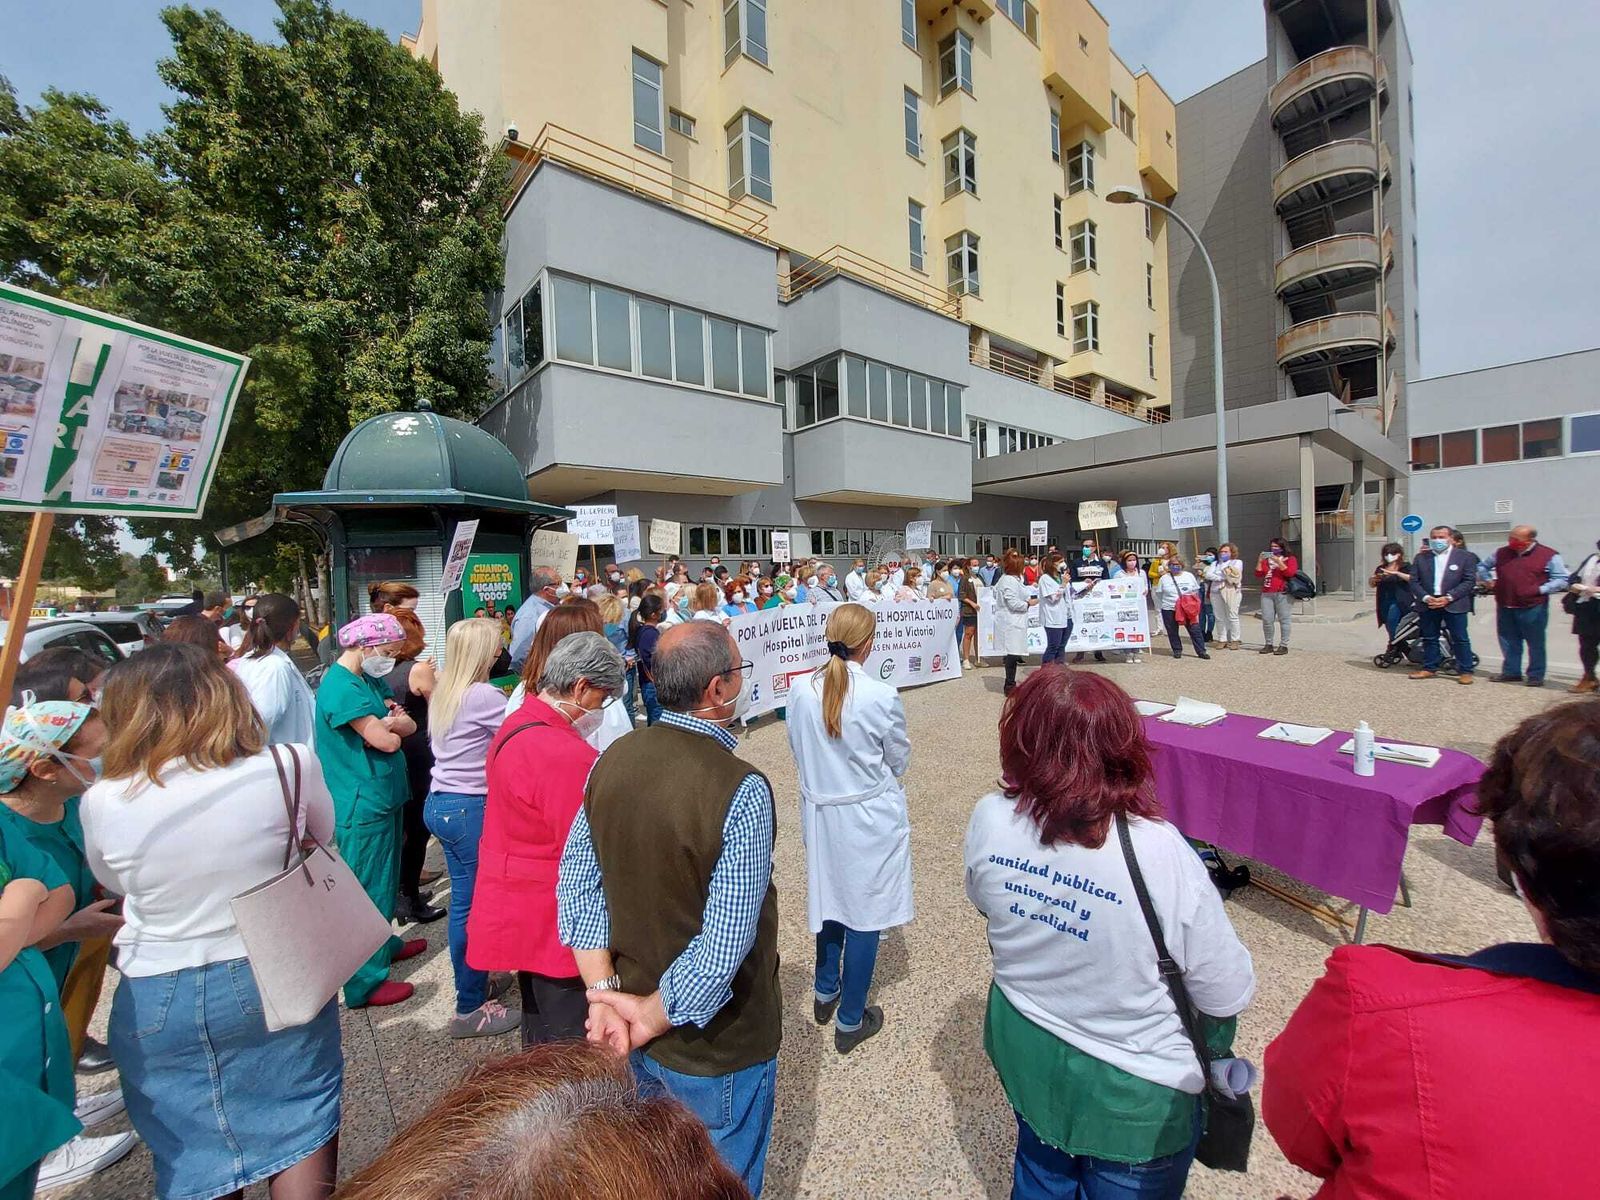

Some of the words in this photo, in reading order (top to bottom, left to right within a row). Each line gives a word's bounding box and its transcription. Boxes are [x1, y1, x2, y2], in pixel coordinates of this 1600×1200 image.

[473, 564, 509, 573] CUANDO
[470, 573, 501, 584] JUEGAS
[472, 583, 512, 593] JUGAMOS
[478, 591, 508, 602] TODOS
[32, 609, 48, 617] TAXI
[876, 611, 885, 623] EL
[886, 611, 925, 623] HOSPITAL
[926, 606, 953, 622] CLÍNICO
[738, 625, 757, 642] POR
[759, 622, 769, 637] LA
[771, 616, 806, 633] VUELTA
[806, 613, 818, 627] DEL
[883, 627, 893, 639] de
[895, 627, 903, 638] la
[905, 624, 936, 638] Victoria)
[762, 634, 804, 657] (Hospital
[882, 643, 891, 651] EN
[892, 640, 923, 650] MÁLAGA
[779, 654, 800, 664] DOS
[988, 853, 1050, 879] sanidad
[1051, 869, 1124, 906] pública,
[1004, 880, 1077, 914] universal
[1080, 908, 1092, 921] y
[1009, 902, 1026, 918] de
[1030, 911, 1090, 942] calidad
